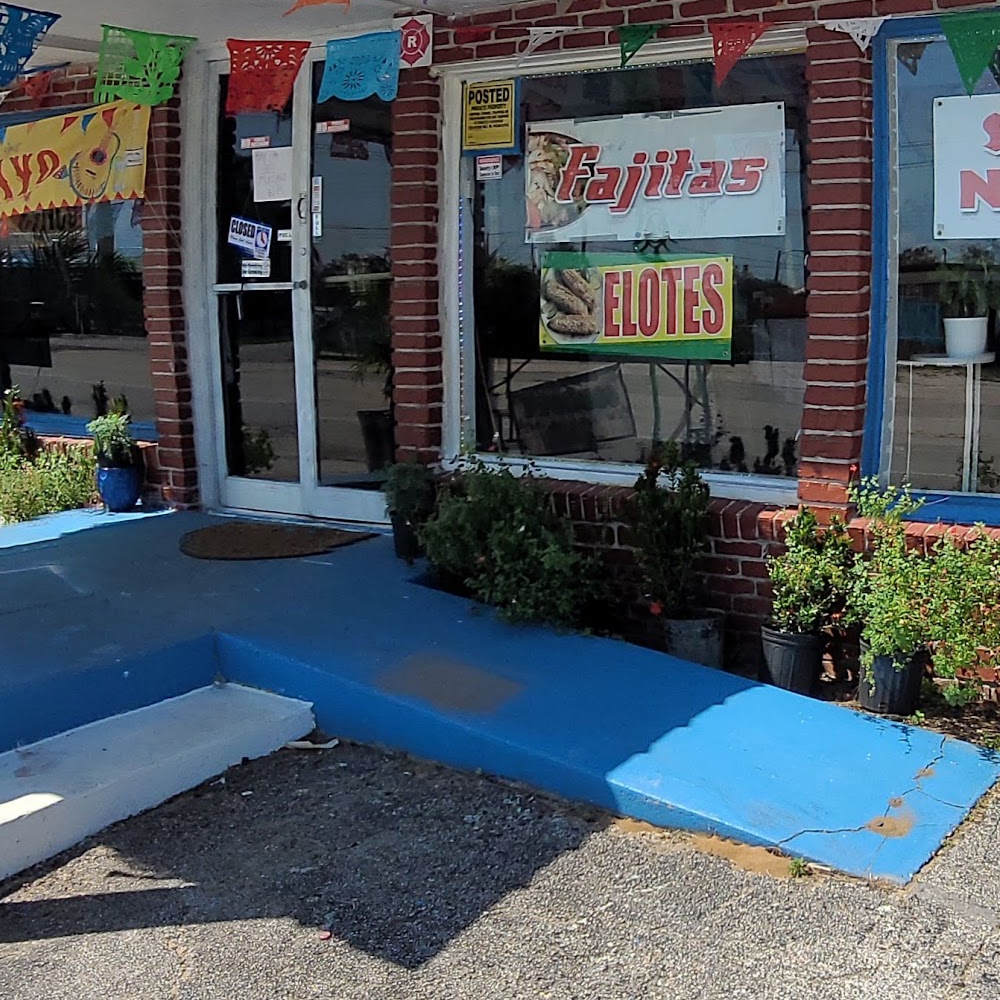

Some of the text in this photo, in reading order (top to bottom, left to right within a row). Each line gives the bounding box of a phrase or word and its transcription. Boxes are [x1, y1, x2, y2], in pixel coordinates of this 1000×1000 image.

[407, 35, 418, 48] R
[468, 87, 510, 105] POSTED
[556, 144, 769, 215] Fajitas
[230, 219, 256, 239] CLOSED
[602, 262, 725, 339] ELOTES
